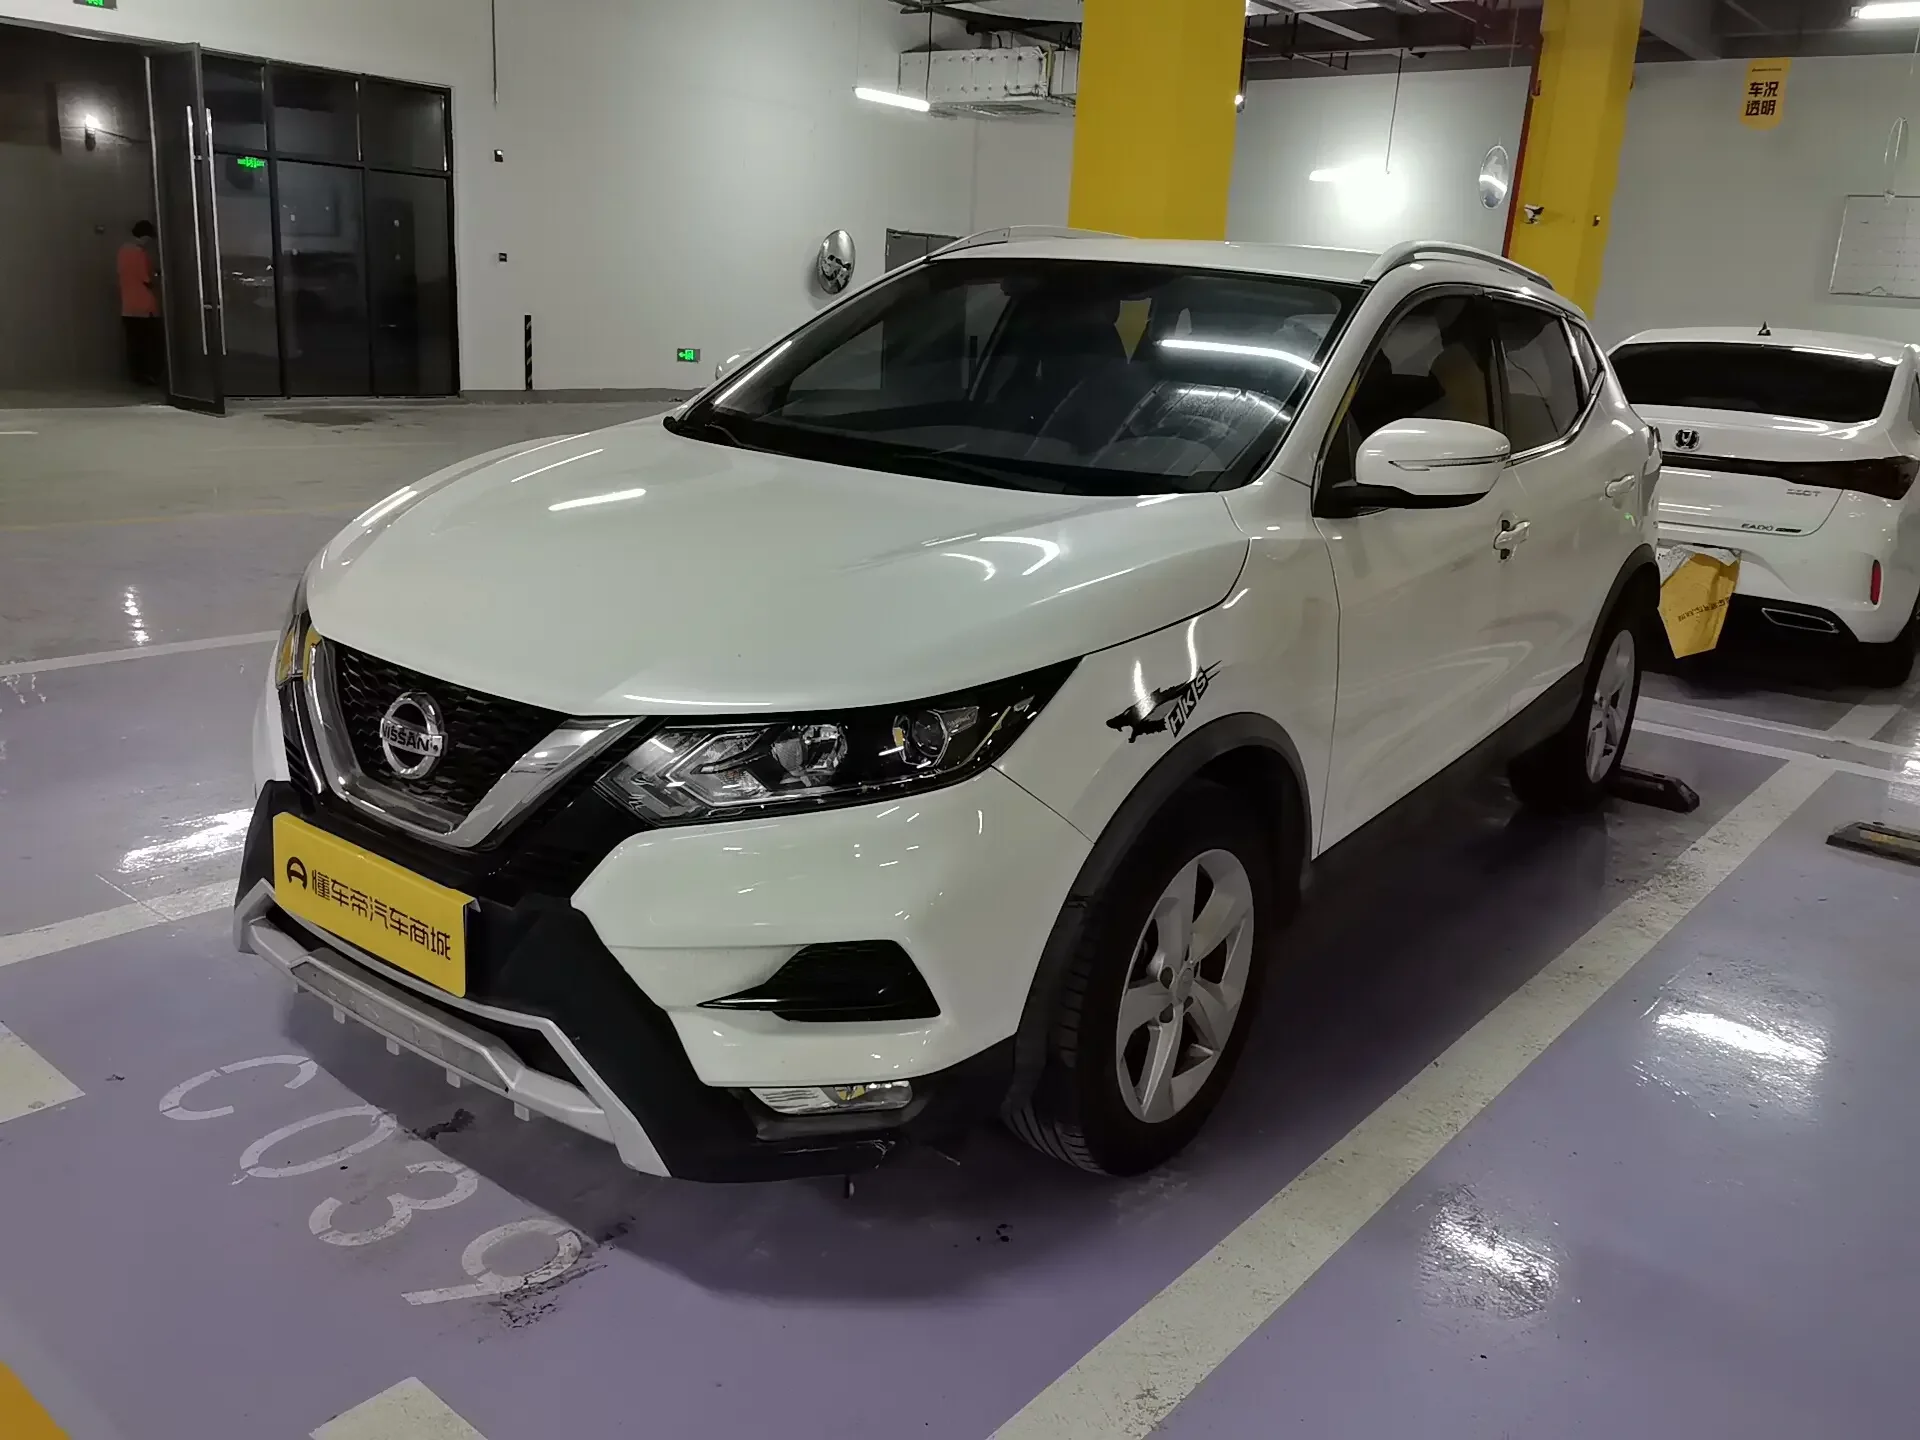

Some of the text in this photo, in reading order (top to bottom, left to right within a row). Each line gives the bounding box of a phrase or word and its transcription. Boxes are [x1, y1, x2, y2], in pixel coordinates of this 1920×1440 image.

[1745, 100, 1776, 116] 透明
[1748, 81, 1779, 97] 车况
[1169, 671, 1208, 735] HKS
[382, 725, 429, 752] NISSAN
[311, 869, 451, 961] 懂车帝汽车商城
[158, 1054, 582, 1306] C039
